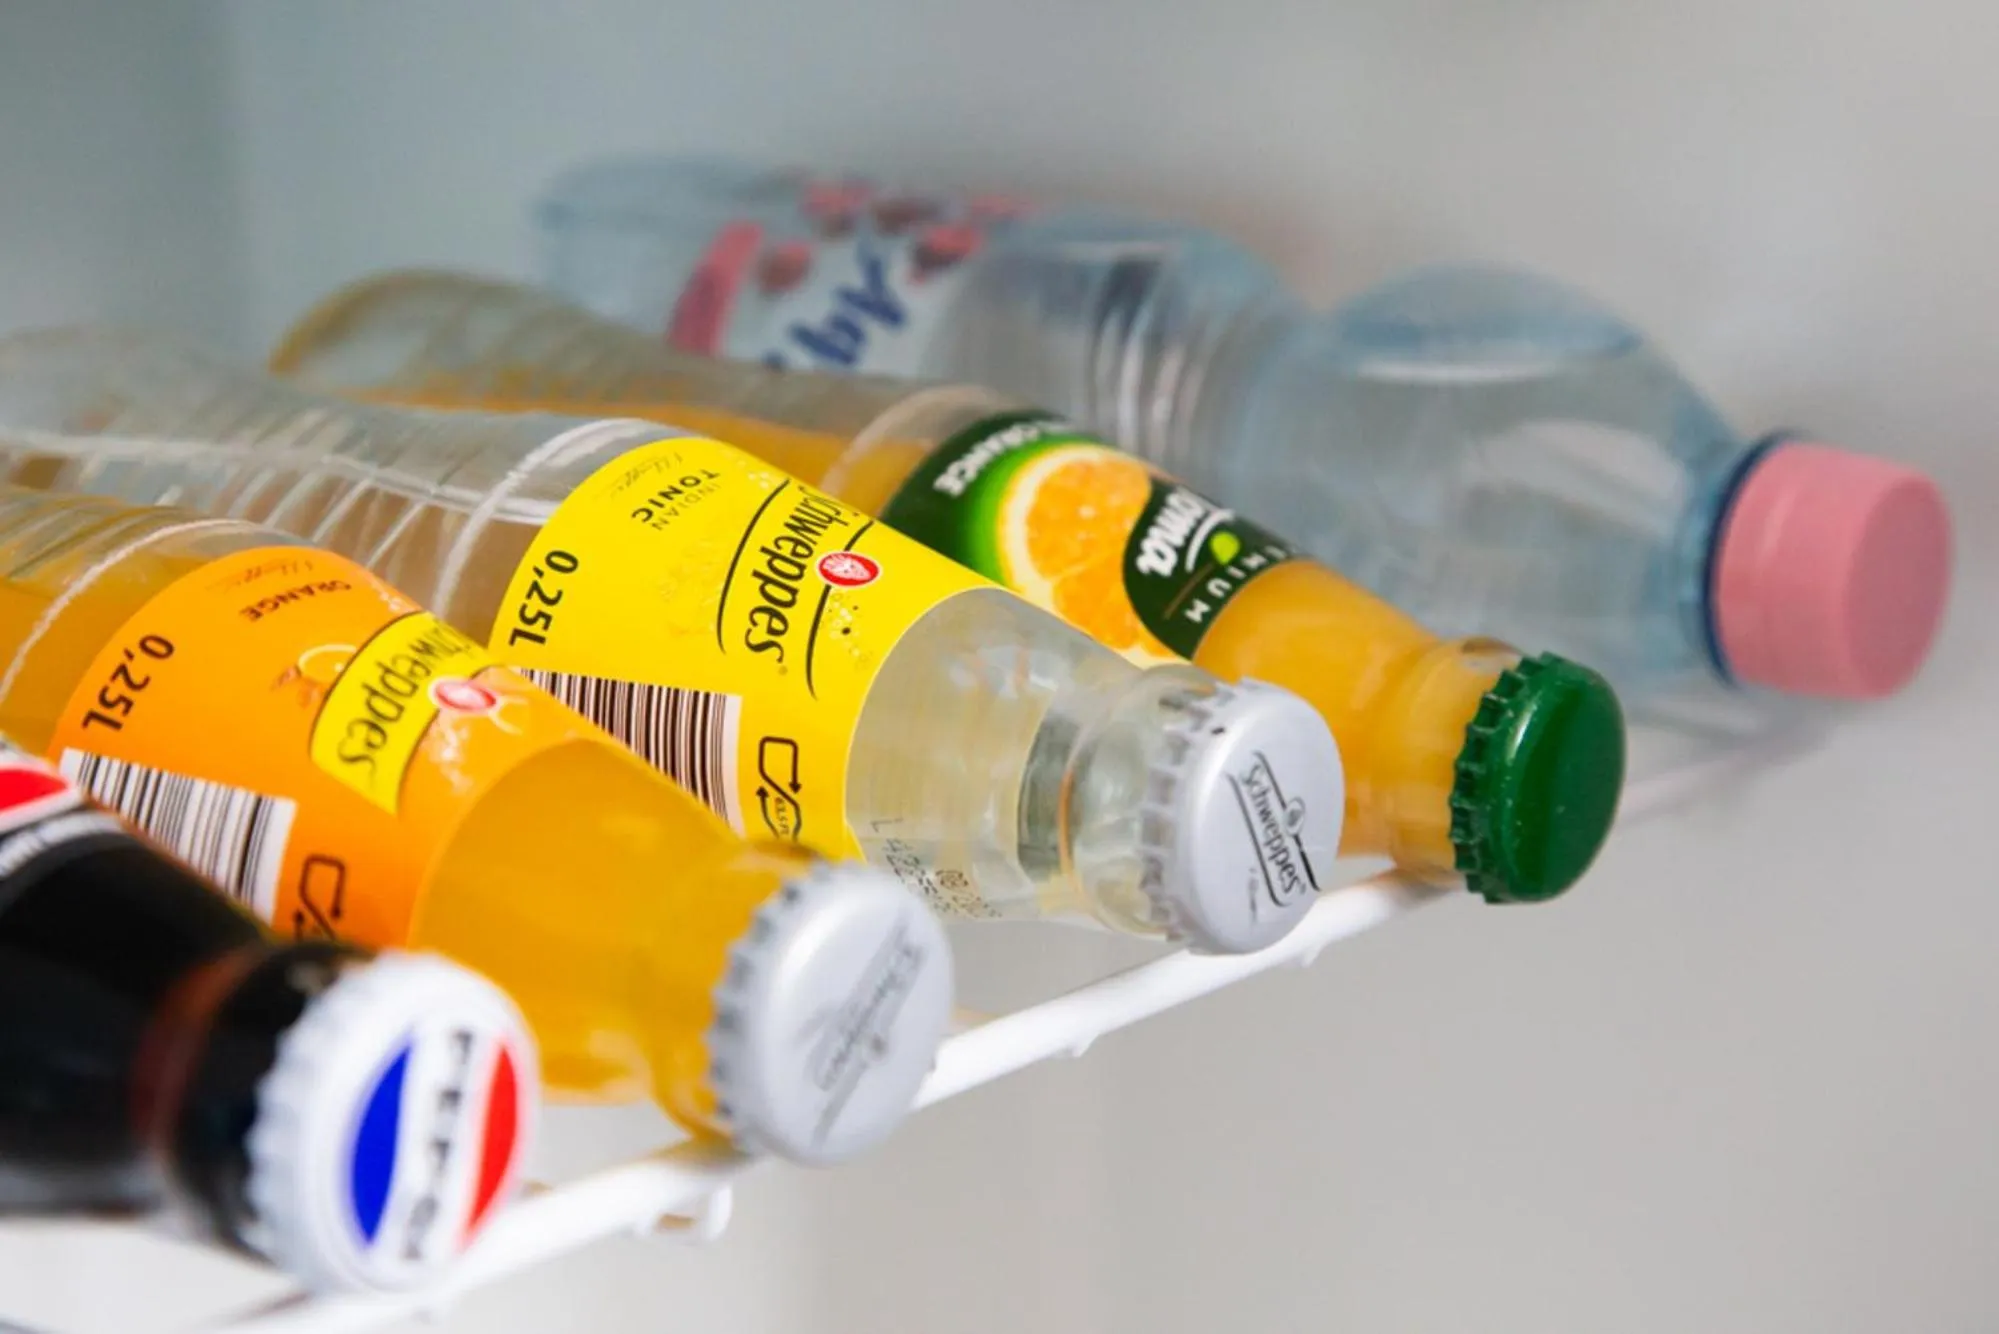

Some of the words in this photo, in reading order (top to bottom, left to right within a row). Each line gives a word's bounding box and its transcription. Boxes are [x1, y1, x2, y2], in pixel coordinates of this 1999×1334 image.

[762, 222, 910, 372] Aq
[630, 468, 721, 523] TONIC
[239, 579, 353, 623] ORANGE
[508, 549, 580, 648] 0,25L
[743, 485, 850, 665] Schweppes
[80, 633, 177, 732] 0,25L
[336, 621, 472, 786] hweppes
[1240, 762, 1301, 895] Schweppes
